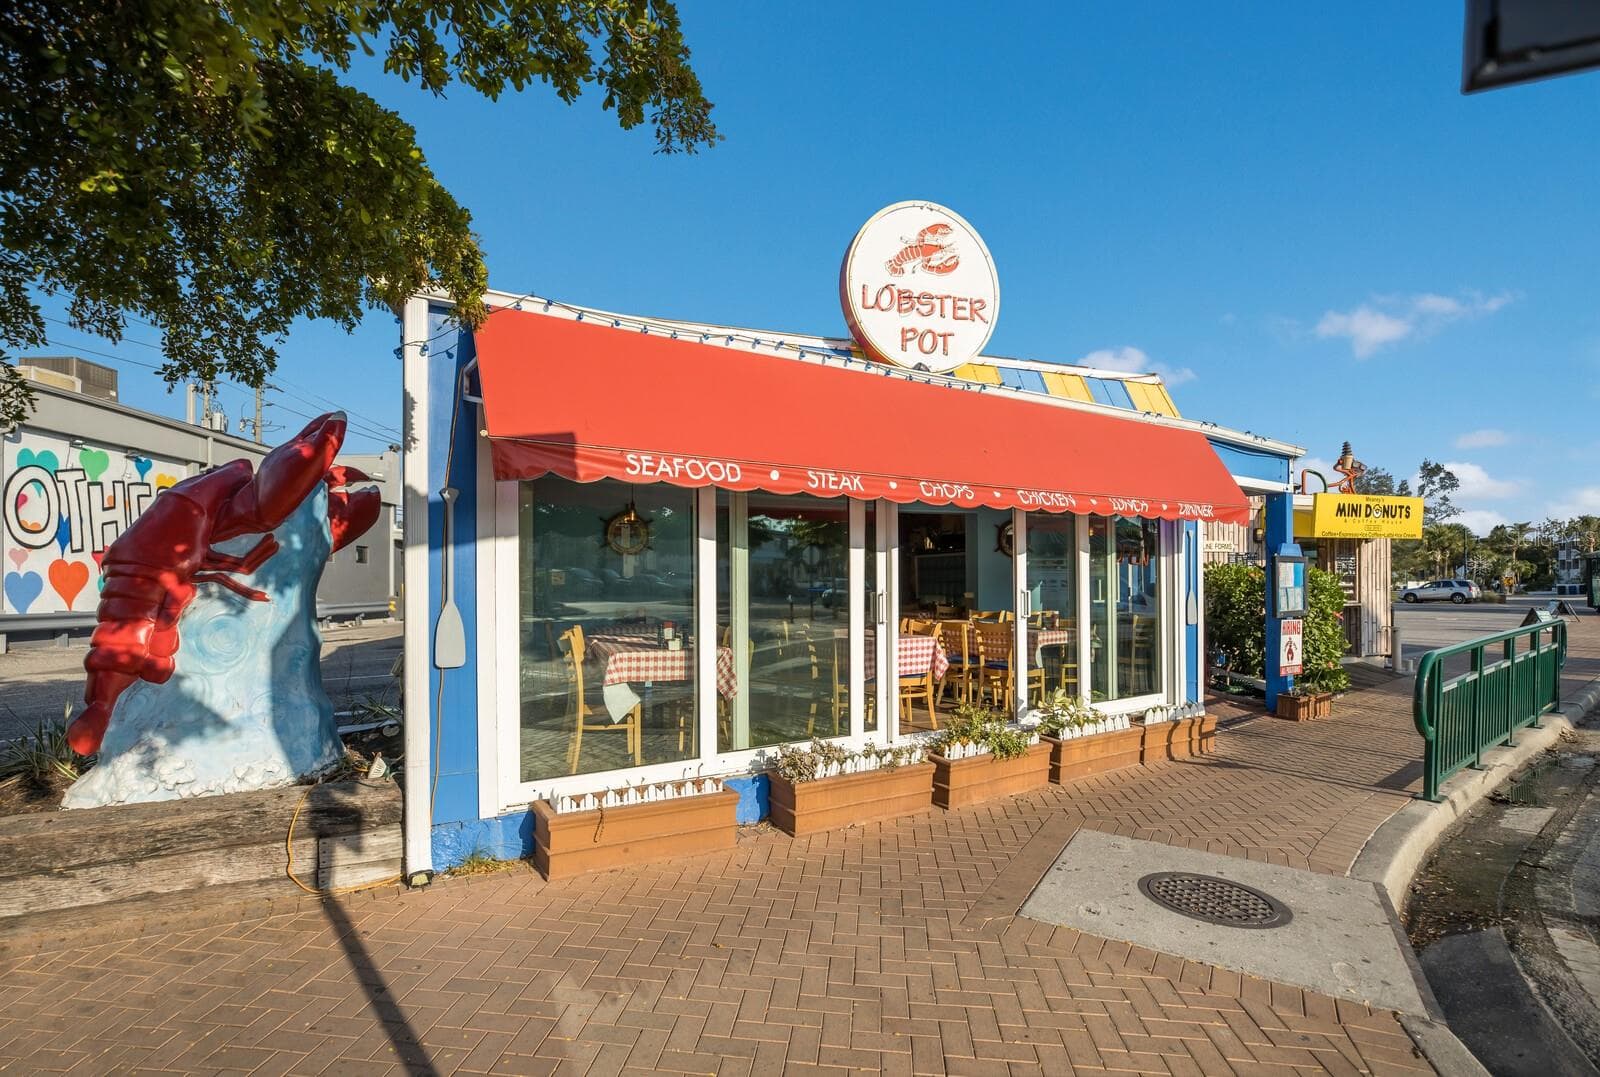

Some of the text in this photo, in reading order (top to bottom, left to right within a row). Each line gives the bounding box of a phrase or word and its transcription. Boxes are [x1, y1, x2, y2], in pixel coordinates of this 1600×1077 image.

[861, 283, 989, 325] LOBSTER
[900, 326, 955, 356] POT
[625, 453, 1214, 518] SEAFOOD STEAK CHOPS CHICKEN LUNCH DINNER
[1336, 502, 1411, 519] MINI DONUTS
